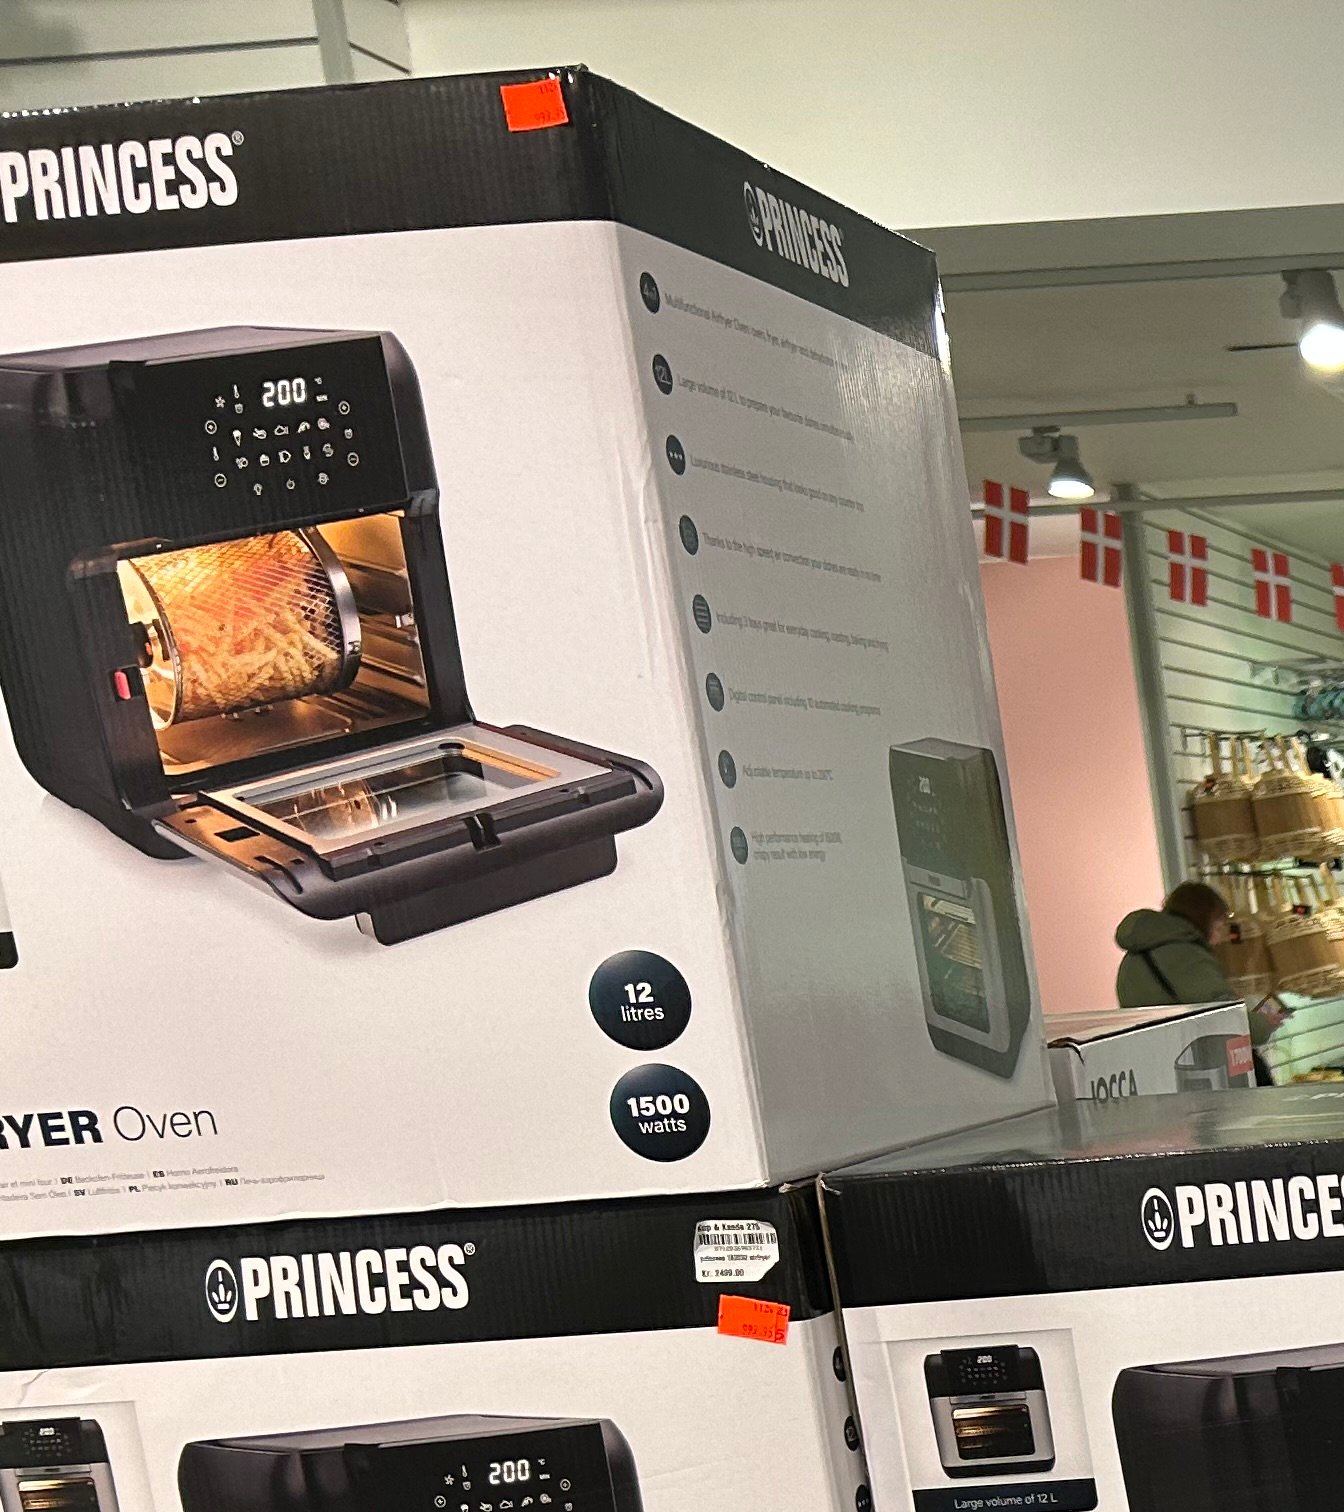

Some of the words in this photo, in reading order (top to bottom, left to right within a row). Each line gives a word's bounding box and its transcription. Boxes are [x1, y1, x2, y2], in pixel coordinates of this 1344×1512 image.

[1, 132, 239, 222] PRINCESS
[755, 186, 849, 287] PRINCESS
[262, 377, 306, 407] 200
[624, 983, 654, 1004] 12
[621, 1001, 665, 1024] litres
[626, 1093, 690, 1120] 1500
[113, 1106, 218, 1141] Oven
[638, 1113, 687, 1136] watts
[240, 1243, 470, 1321] PRINCESS
[488, 1459, 530, 1485] 200
[954, 1498, 984, 1511] Large
[986, 1496, 1024, 1507] volume
[1025, 1494, 1036, 1504] of
[1037, 1494, 1049, 1504] 12
[1050, 1493, 1059, 1503] L
